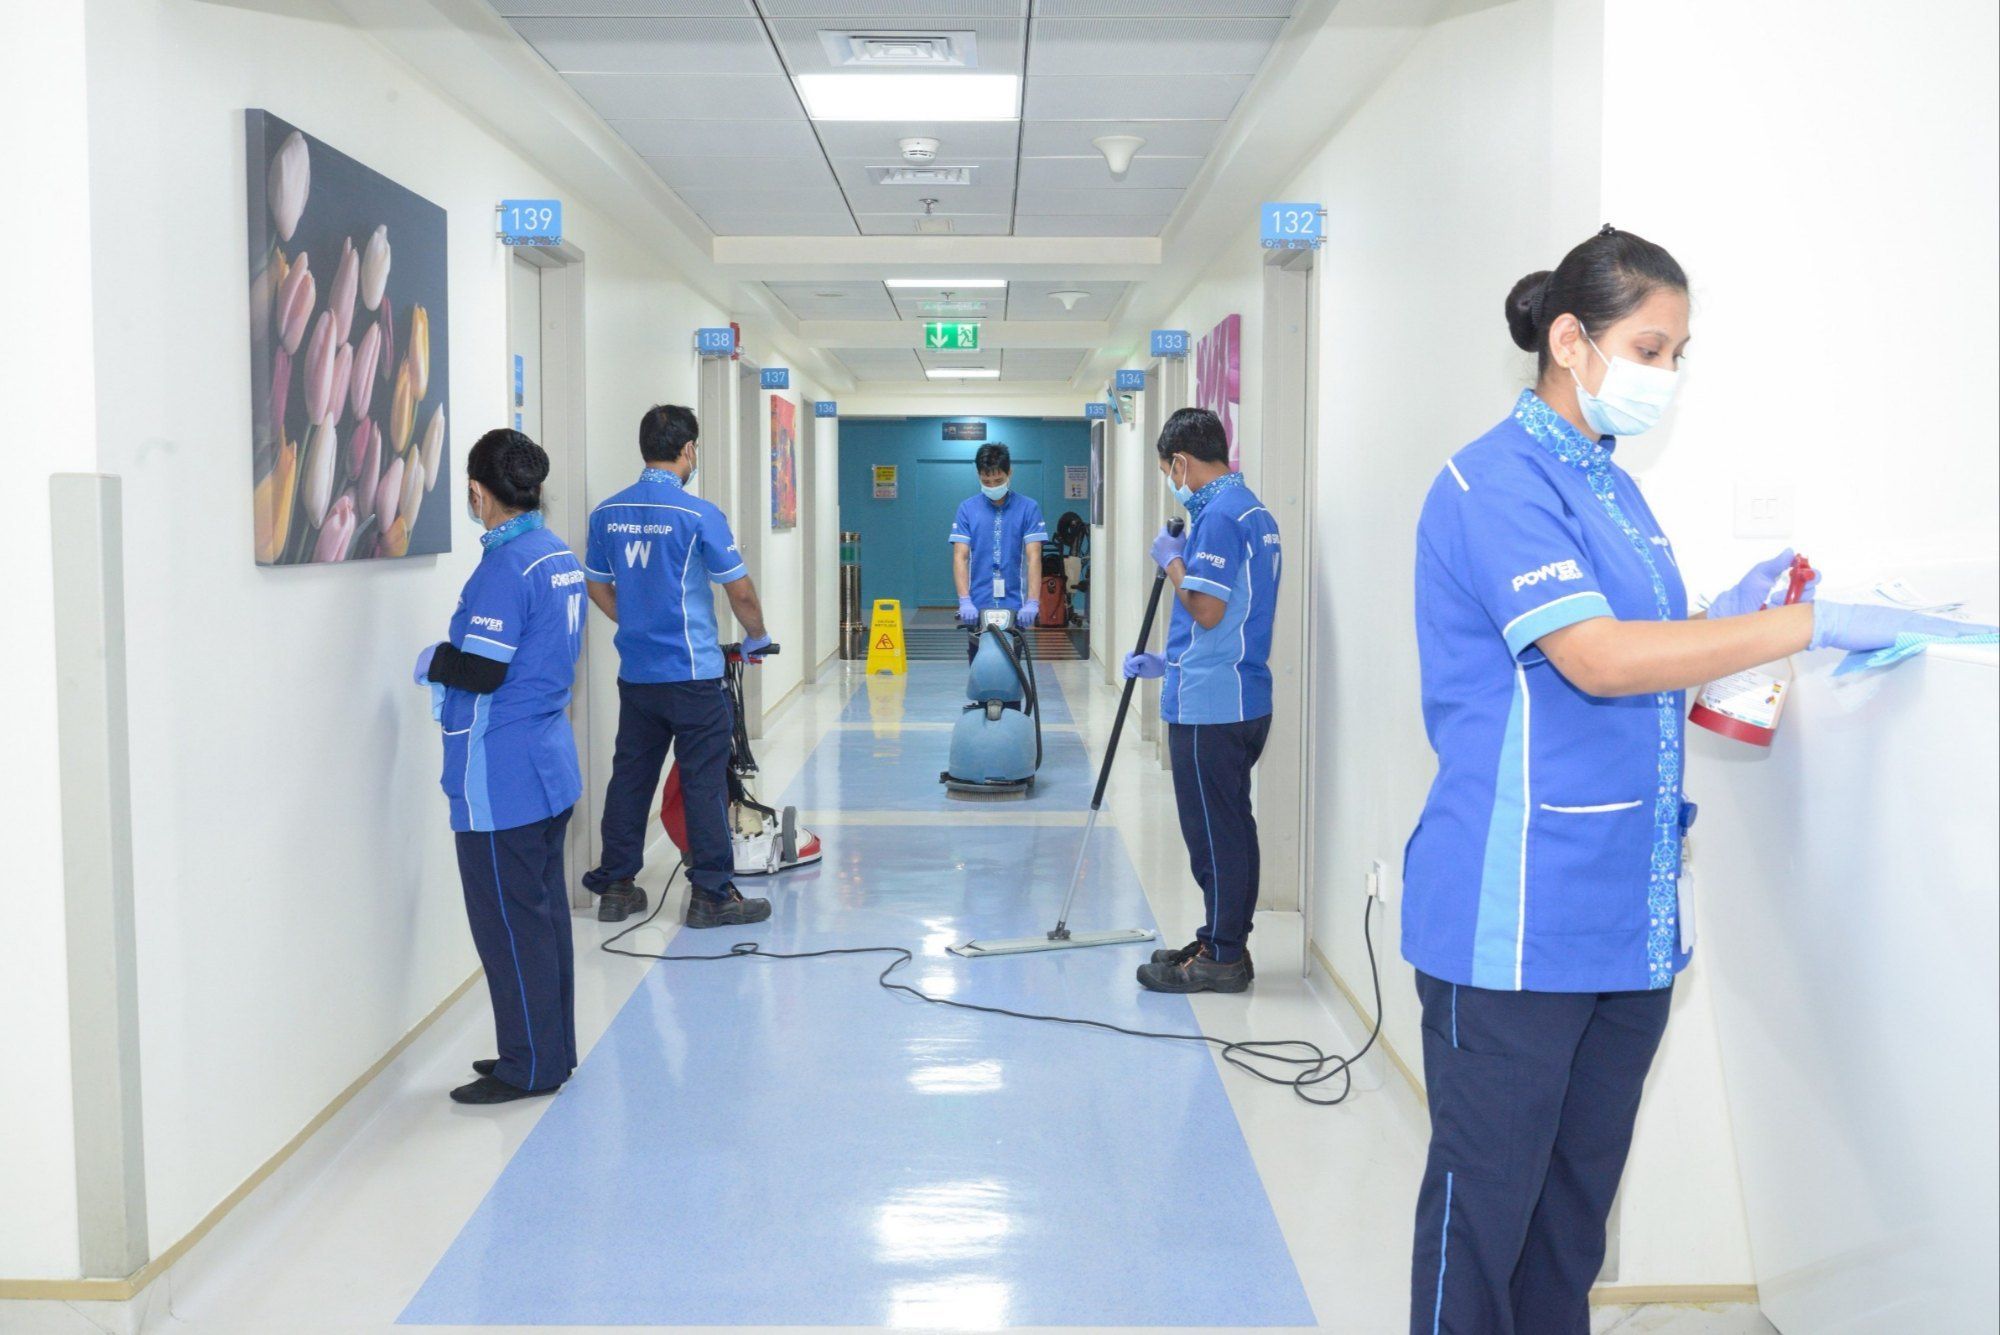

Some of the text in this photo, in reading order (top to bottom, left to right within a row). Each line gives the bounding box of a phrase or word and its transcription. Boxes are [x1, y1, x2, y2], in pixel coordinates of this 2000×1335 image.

[511, 207, 553, 231] 139
[1272, 210, 1314, 234] 132
[703, 332, 730, 347] 138
[1156, 334, 1183, 349] 133
[765, 371, 785, 383] 137
[1120, 373, 1141, 385] 134
[818, 404, 834, 413] 136
[1088, 405, 1104, 415] 135
[607, 523, 673, 535] POWER GROUP
[1512, 559, 1579, 593] POWER
[471, 615, 503, 628] POWER
